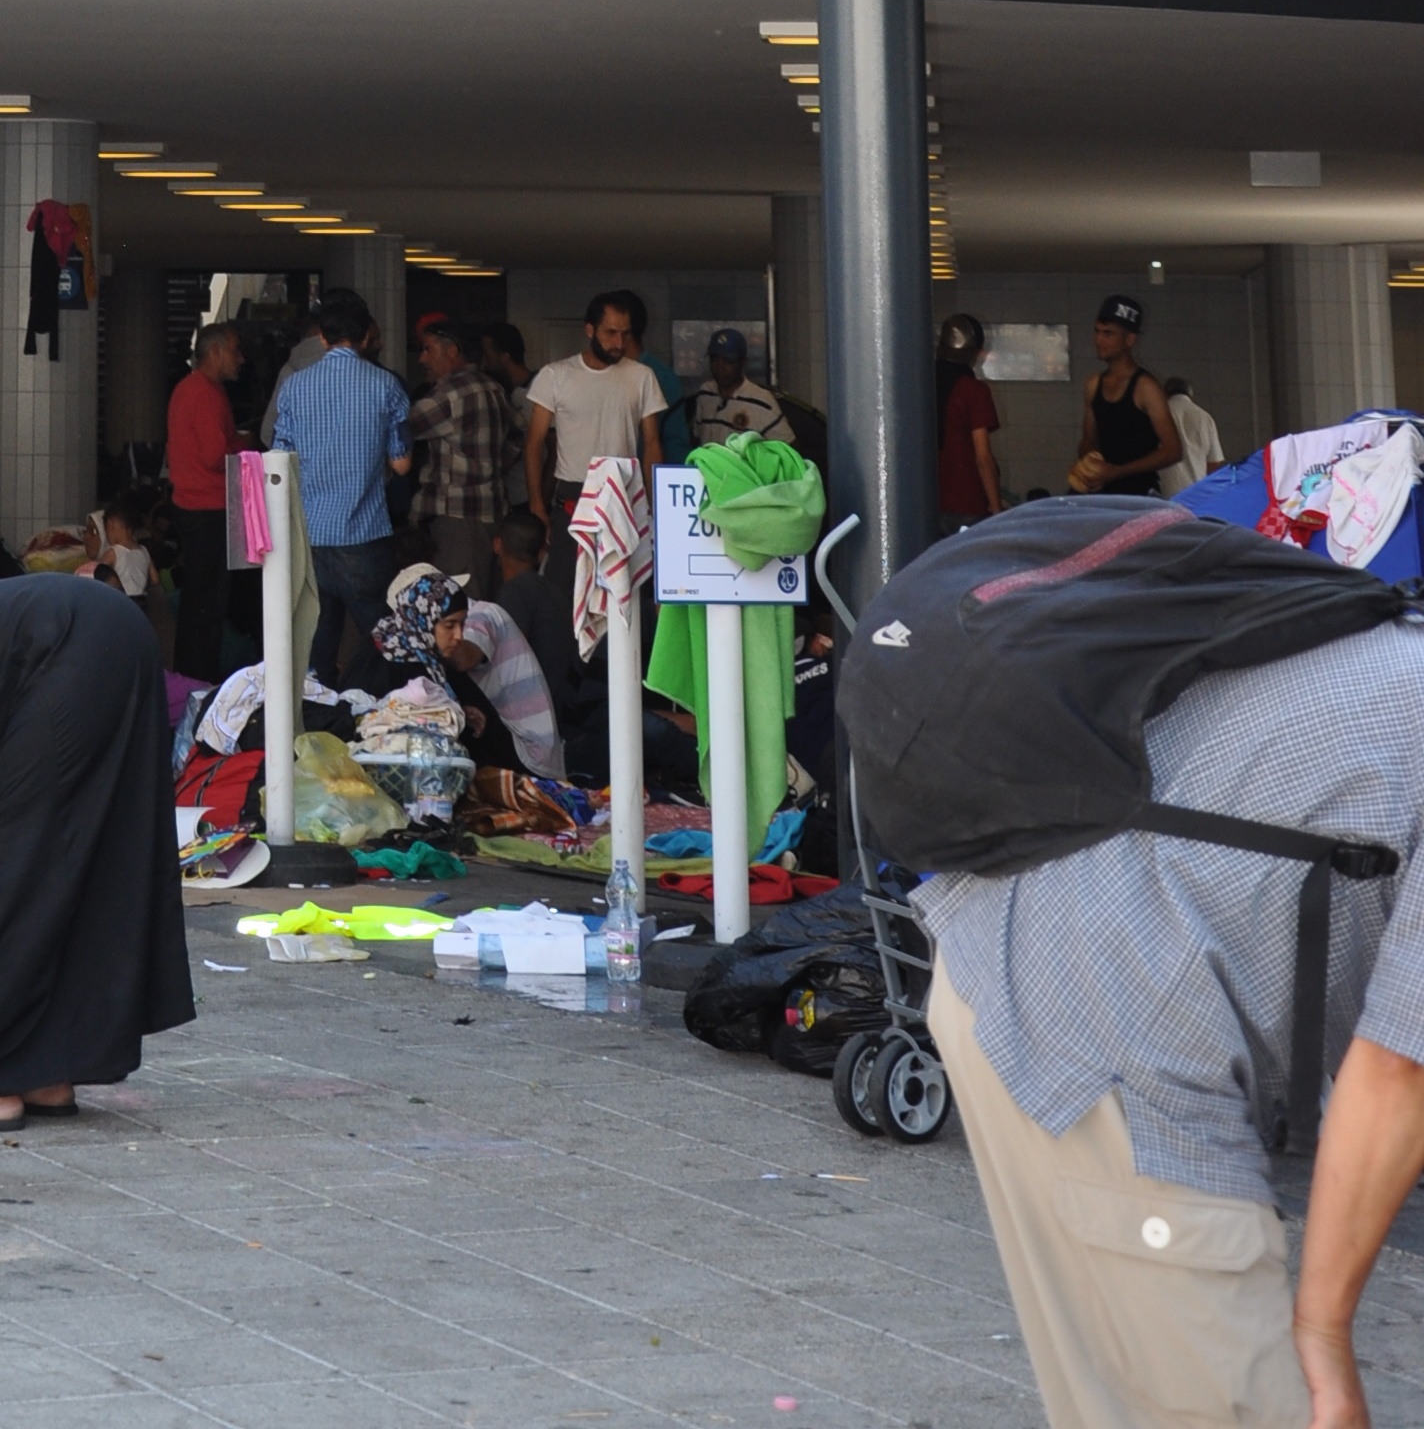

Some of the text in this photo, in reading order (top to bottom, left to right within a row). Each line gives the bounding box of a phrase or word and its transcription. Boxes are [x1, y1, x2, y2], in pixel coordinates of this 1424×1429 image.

[1115, 303, 1139, 323] NY
[668, 484, 711, 508] TRA
[794, 662, 829, 684] ONES
